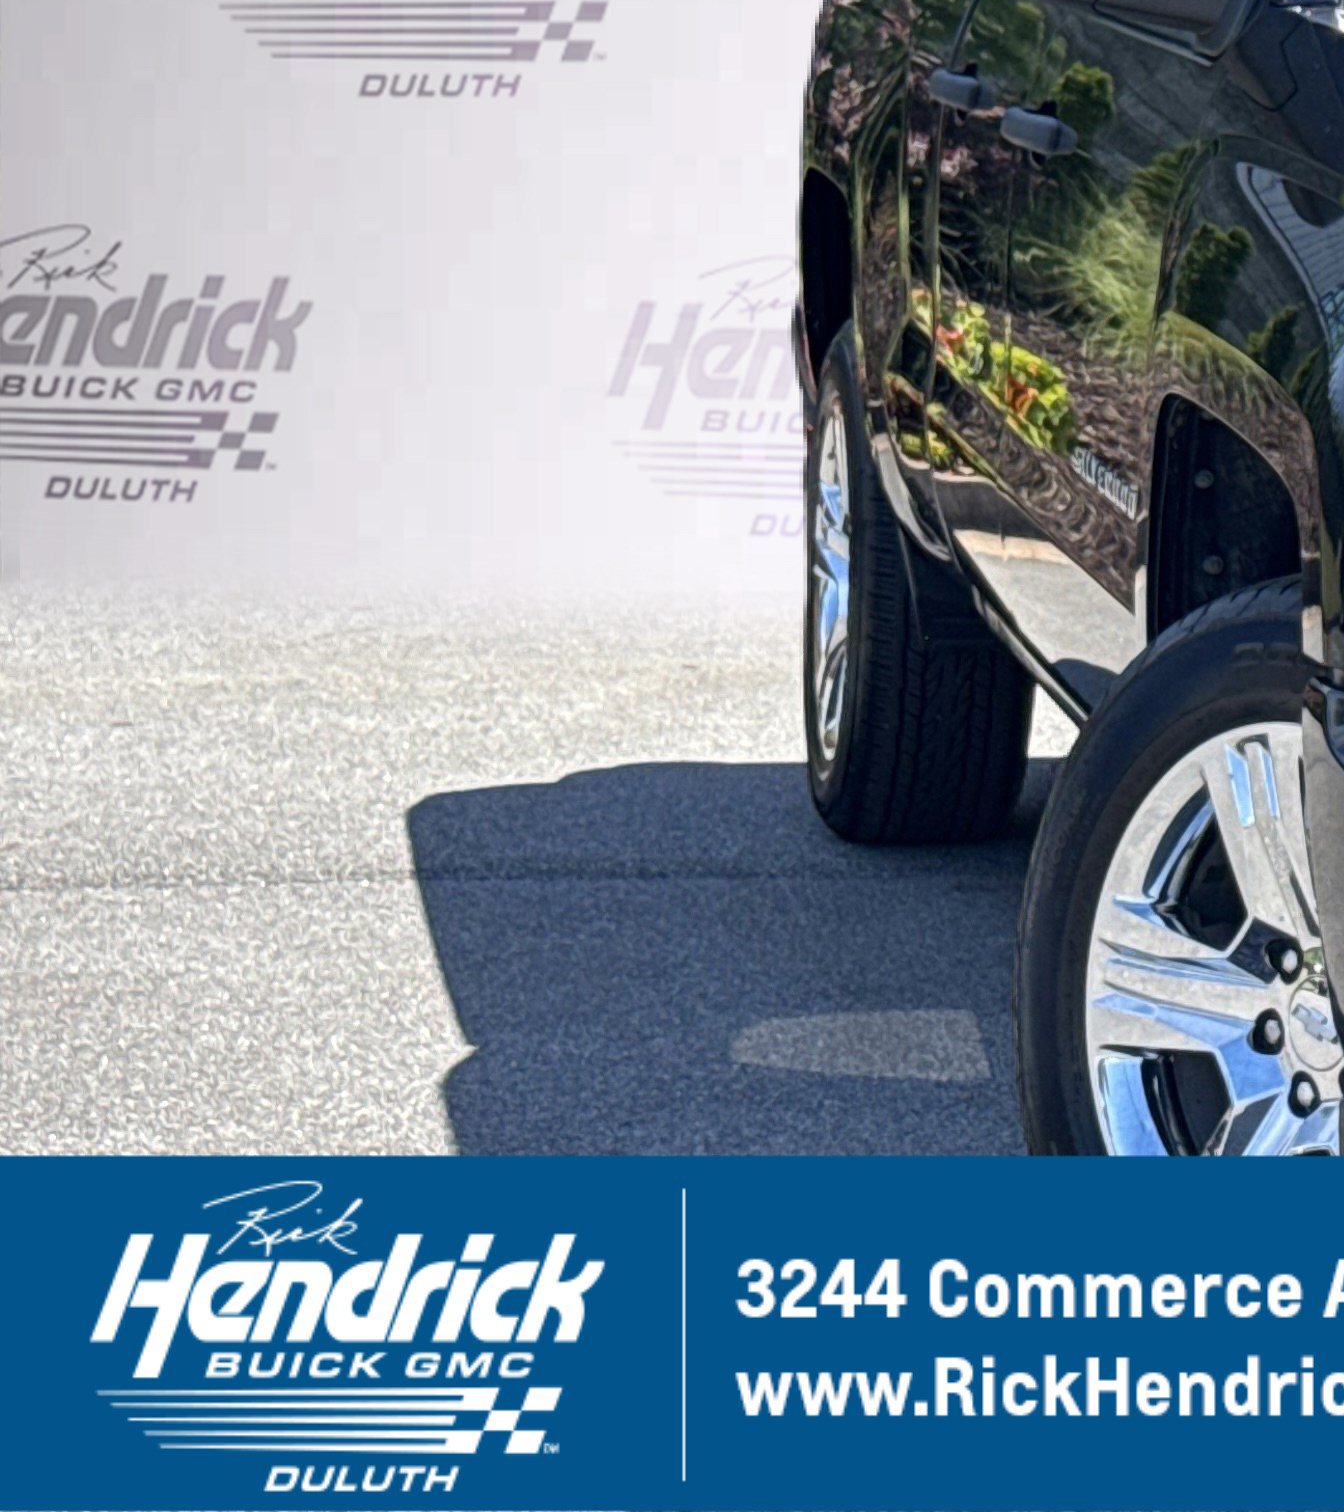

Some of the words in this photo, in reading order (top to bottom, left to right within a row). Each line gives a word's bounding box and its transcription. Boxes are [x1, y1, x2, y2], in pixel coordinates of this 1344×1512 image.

[358, 73, 521, 98] DULUTH
[0, 269, 312, 372] endrick
[0, 374, 138, 400] BUICK
[154, 378, 257, 404] GMC
[44, 476, 197, 502] DULUTH
